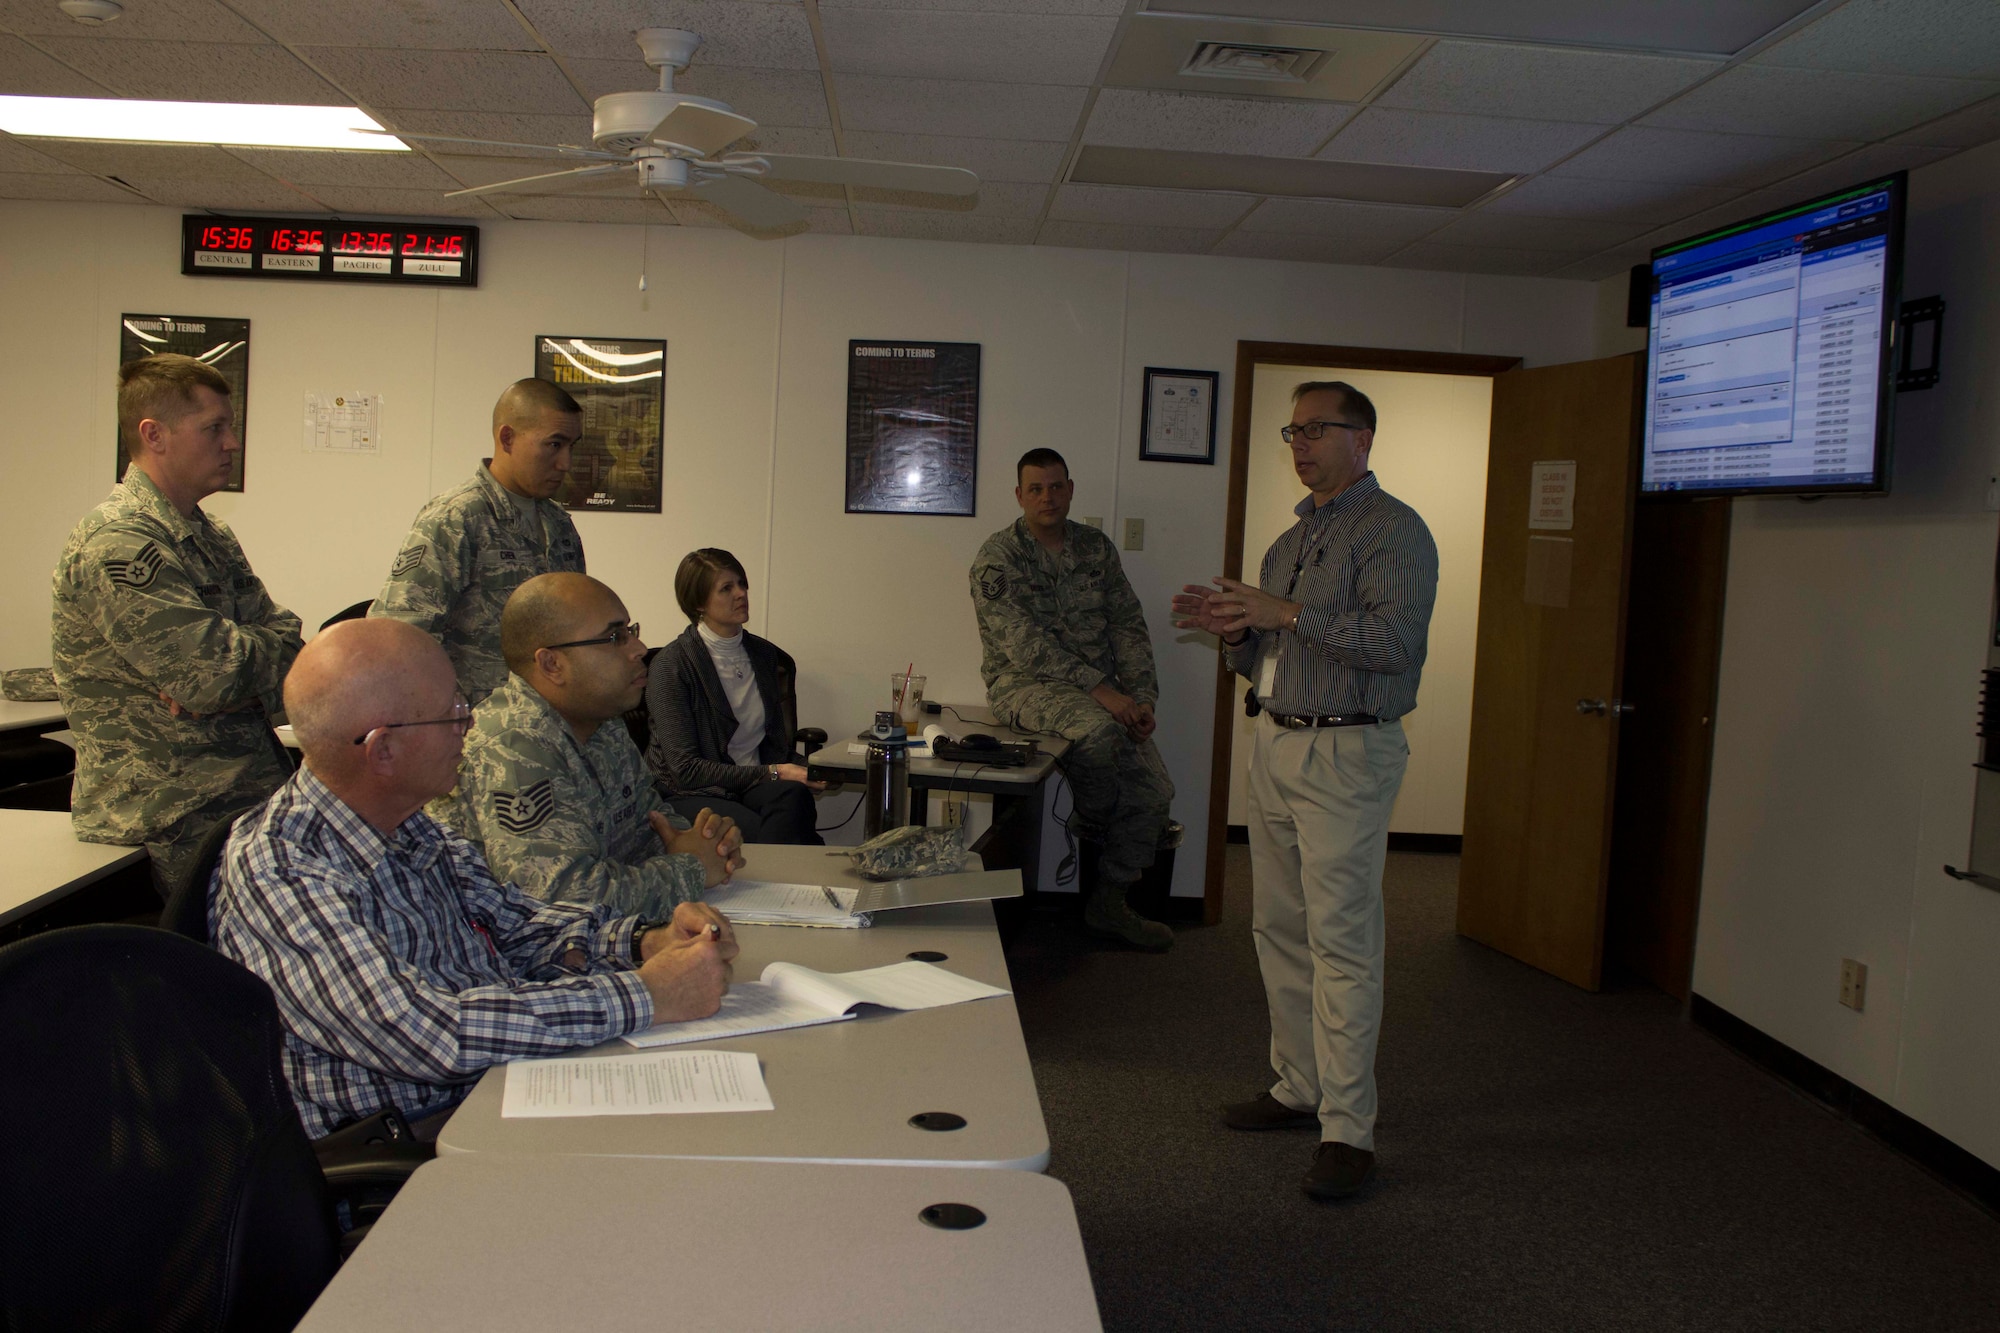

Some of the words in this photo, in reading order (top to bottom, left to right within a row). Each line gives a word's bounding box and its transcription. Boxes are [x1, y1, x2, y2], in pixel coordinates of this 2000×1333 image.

[201, 226, 253, 250] 15:36
[271, 229, 323, 252] 16:36
[340, 231, 393, 254] 13:36
[199, 254, 247, 265] CENTRAL
[268, 257, 314, 267] EASTERN
[343, 260, 383, 270] PACIFIC
[418, 263, 445, 272] ZULU
[163, 321, 175, 332] TO
[176, 322, 206, 333] TERMS
[855, 346, 891, 357] COMING
[892, 347, 904, 358] TO
[905, 348, 936, 359] TERMS
[1542, 473, 1560, 481] CLASS
[1542, 485, 1565, 493] SESSION
[586, 498, 615, 506] READY
[1540, 509, 1564, 517] DISTURB
